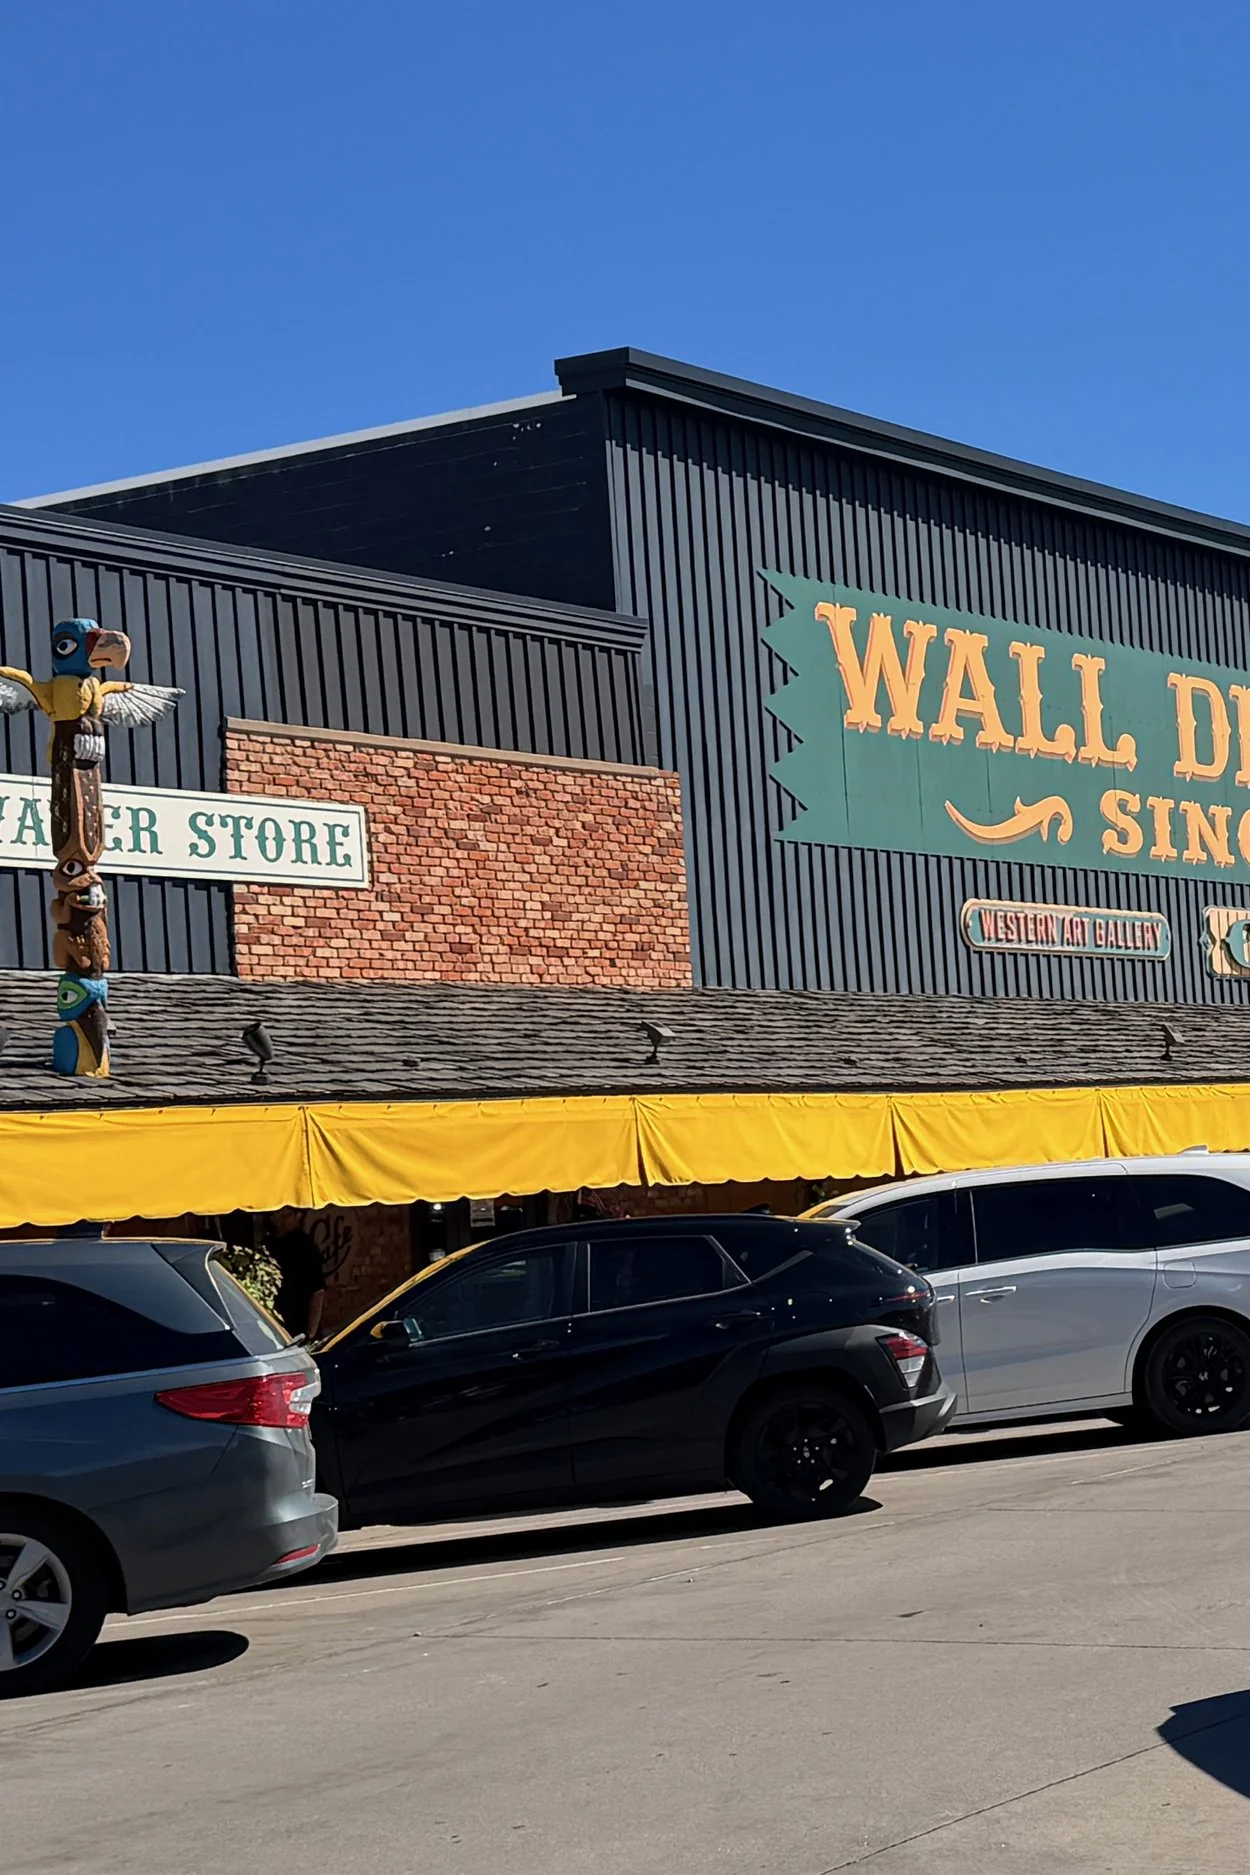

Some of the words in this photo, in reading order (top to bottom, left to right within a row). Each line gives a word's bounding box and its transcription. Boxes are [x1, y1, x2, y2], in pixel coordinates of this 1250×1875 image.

[814, 601, 1138, 772] WALL
[0, 795, 163, 855] AER
[188, 811, 353, 868] STORE
[980, 908, 1058, 944] WESTERN
[1062, 915, 1090, 947] ART
[1094, 917, 1162, 951] GALLERY
